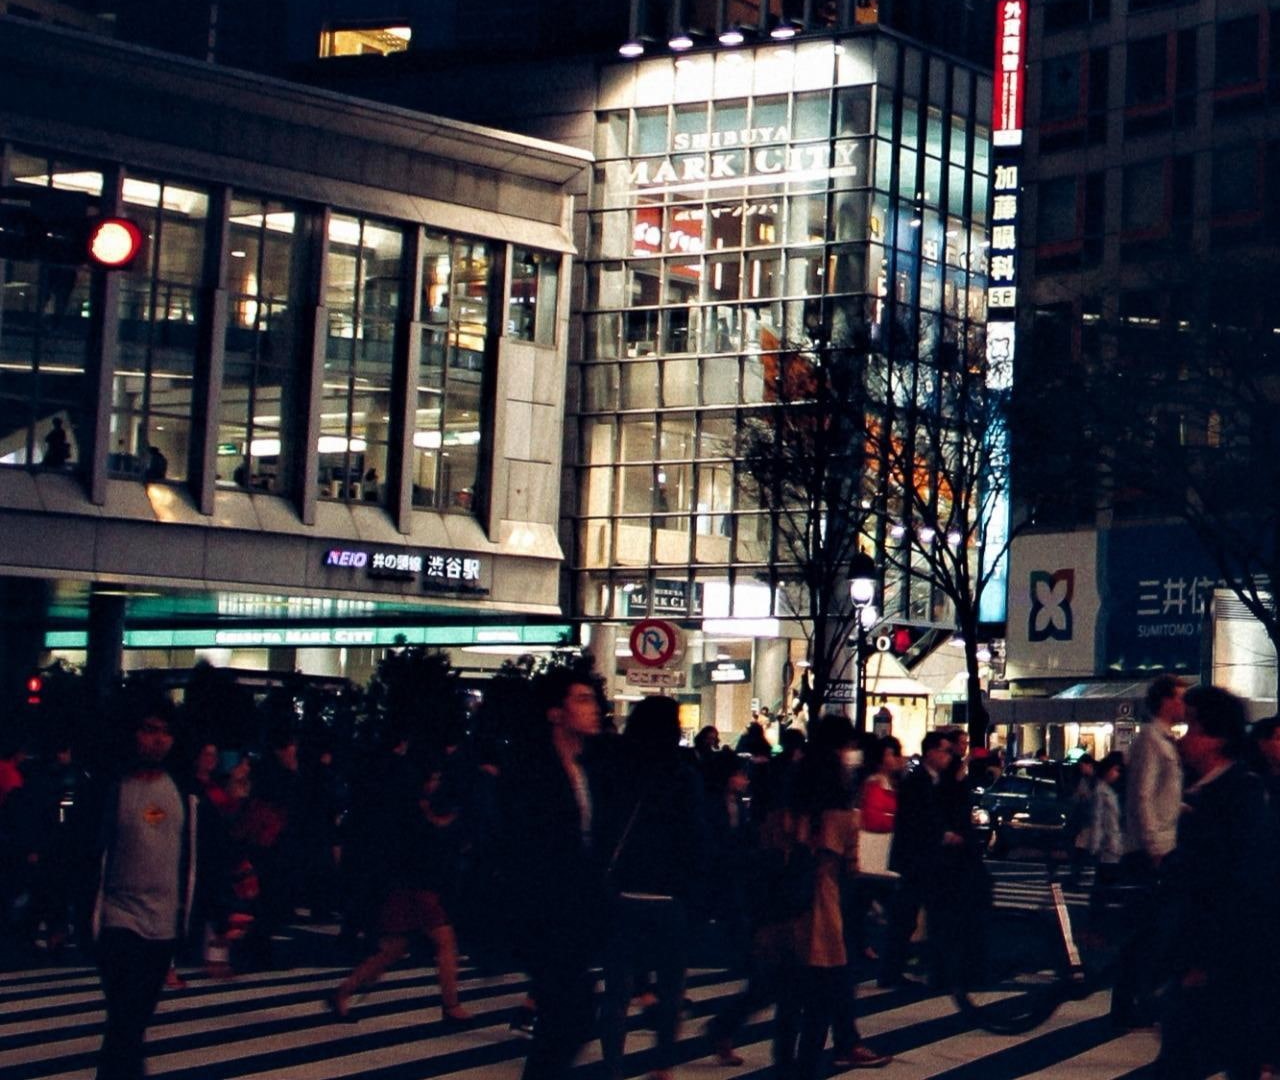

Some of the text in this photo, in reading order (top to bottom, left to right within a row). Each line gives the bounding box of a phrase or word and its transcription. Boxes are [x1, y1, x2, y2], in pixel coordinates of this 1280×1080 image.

[674, 126, 789, 151] SHIBUYA
[617, 142, 859, 185] MARK CITY
[427, 554, 481, 580] 渋谷駅
[1137, 624, 1194, 638] SUMITOMO
